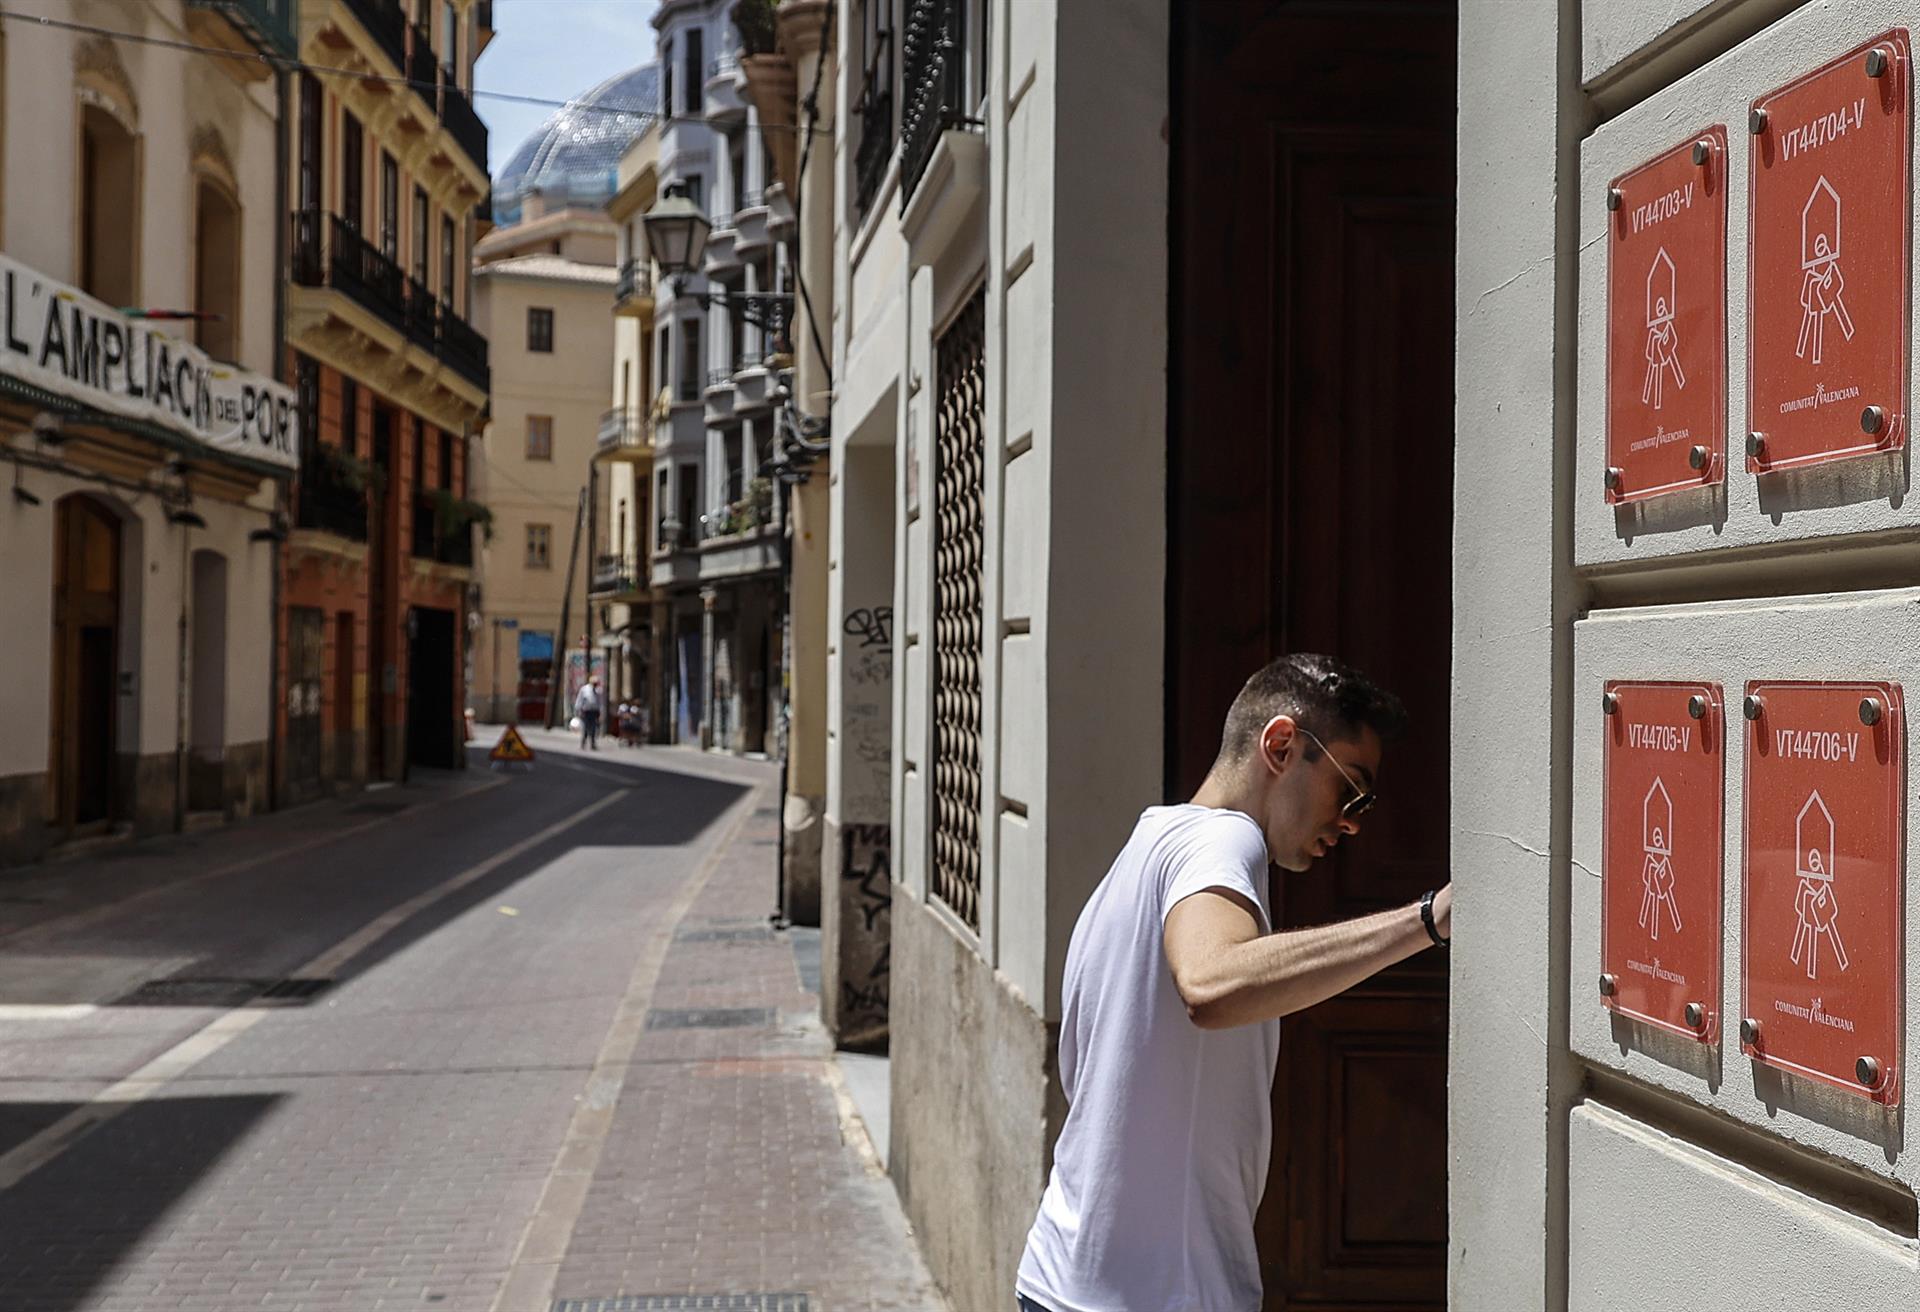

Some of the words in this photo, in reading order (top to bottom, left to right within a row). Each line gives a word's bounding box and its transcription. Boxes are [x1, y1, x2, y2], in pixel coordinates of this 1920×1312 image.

[1782, 97, 1865, 161] VT44704-V
[1632, 181, 1694, 234] VT44703-V
[216, 396, 241, 424] DEL
[1780, 395, 1815, 414] COMUNITAT
[1819, 386, 1860, 405] VALENCIANA
[1628, 723, 1690, 752] VT44705-V
[1776, 729, 1859, 762] VT44706-V
[1775, 1000, 1810, 1019] COMUNITAT
[1814, 1009, 1855, 1033] VALENCIANA
